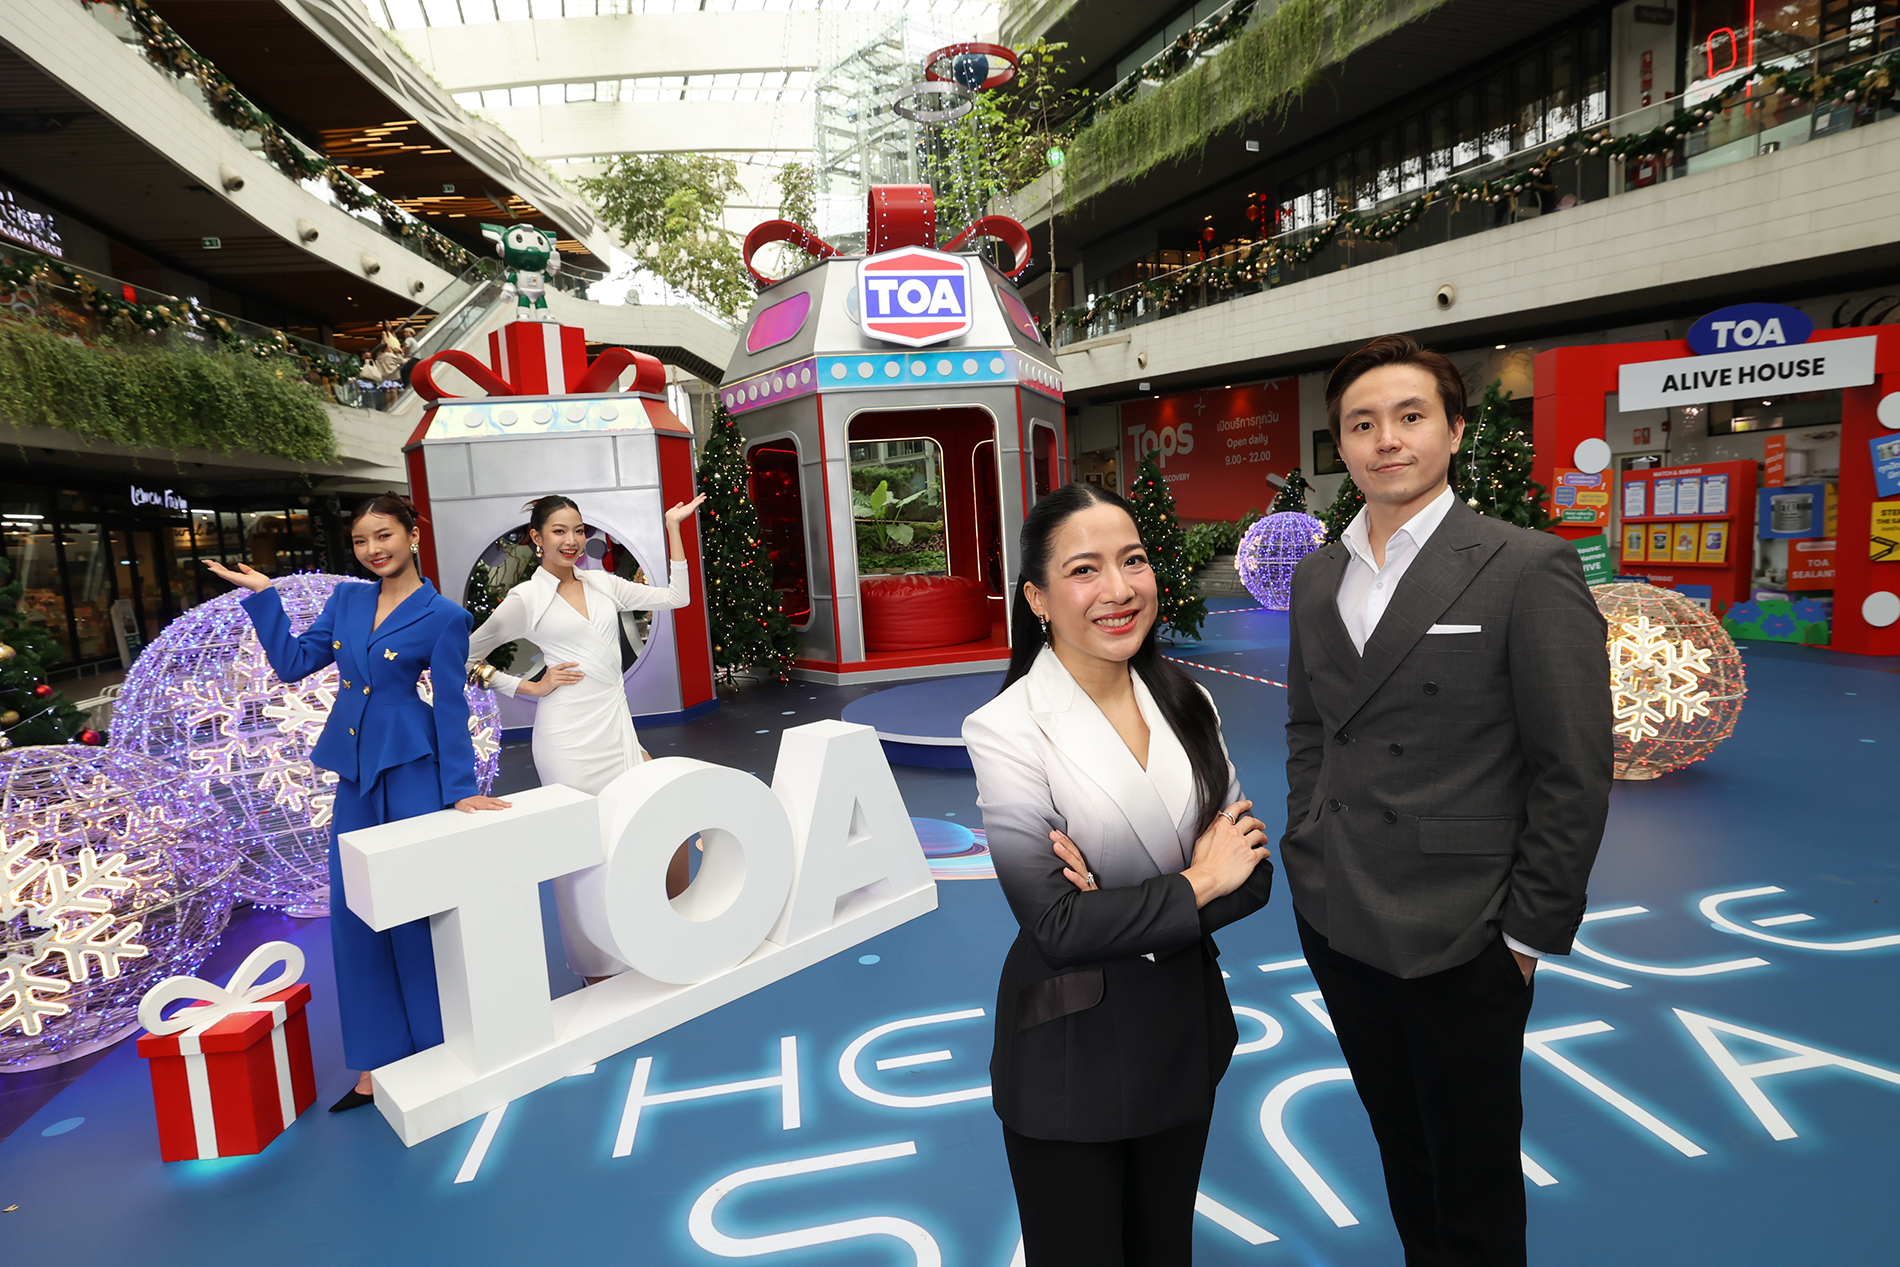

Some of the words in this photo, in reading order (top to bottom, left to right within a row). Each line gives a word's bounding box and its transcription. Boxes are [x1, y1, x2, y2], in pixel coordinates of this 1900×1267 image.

[868, 278, 962, 315] TOA
[1711, 317, 1787, 349] TOA
[1661, 368, 1732, 394] ALIVE
[1738, 357, 1826, 384] HOUSE
[1216, 411, 1279, 432] เปิดบริการทุกวัน
[1127, 422, 1195, 468] Tops
[1226, 438, 1247, 450] Open
[1248, 433, 1269, 446] daily
[1225, 454, 1242, 466] 9.00
[1249, 450, 1271, 463] 22.00
[1807, 558, 1830, 567] TOA
[338, 719, 937, 1078] TOA
